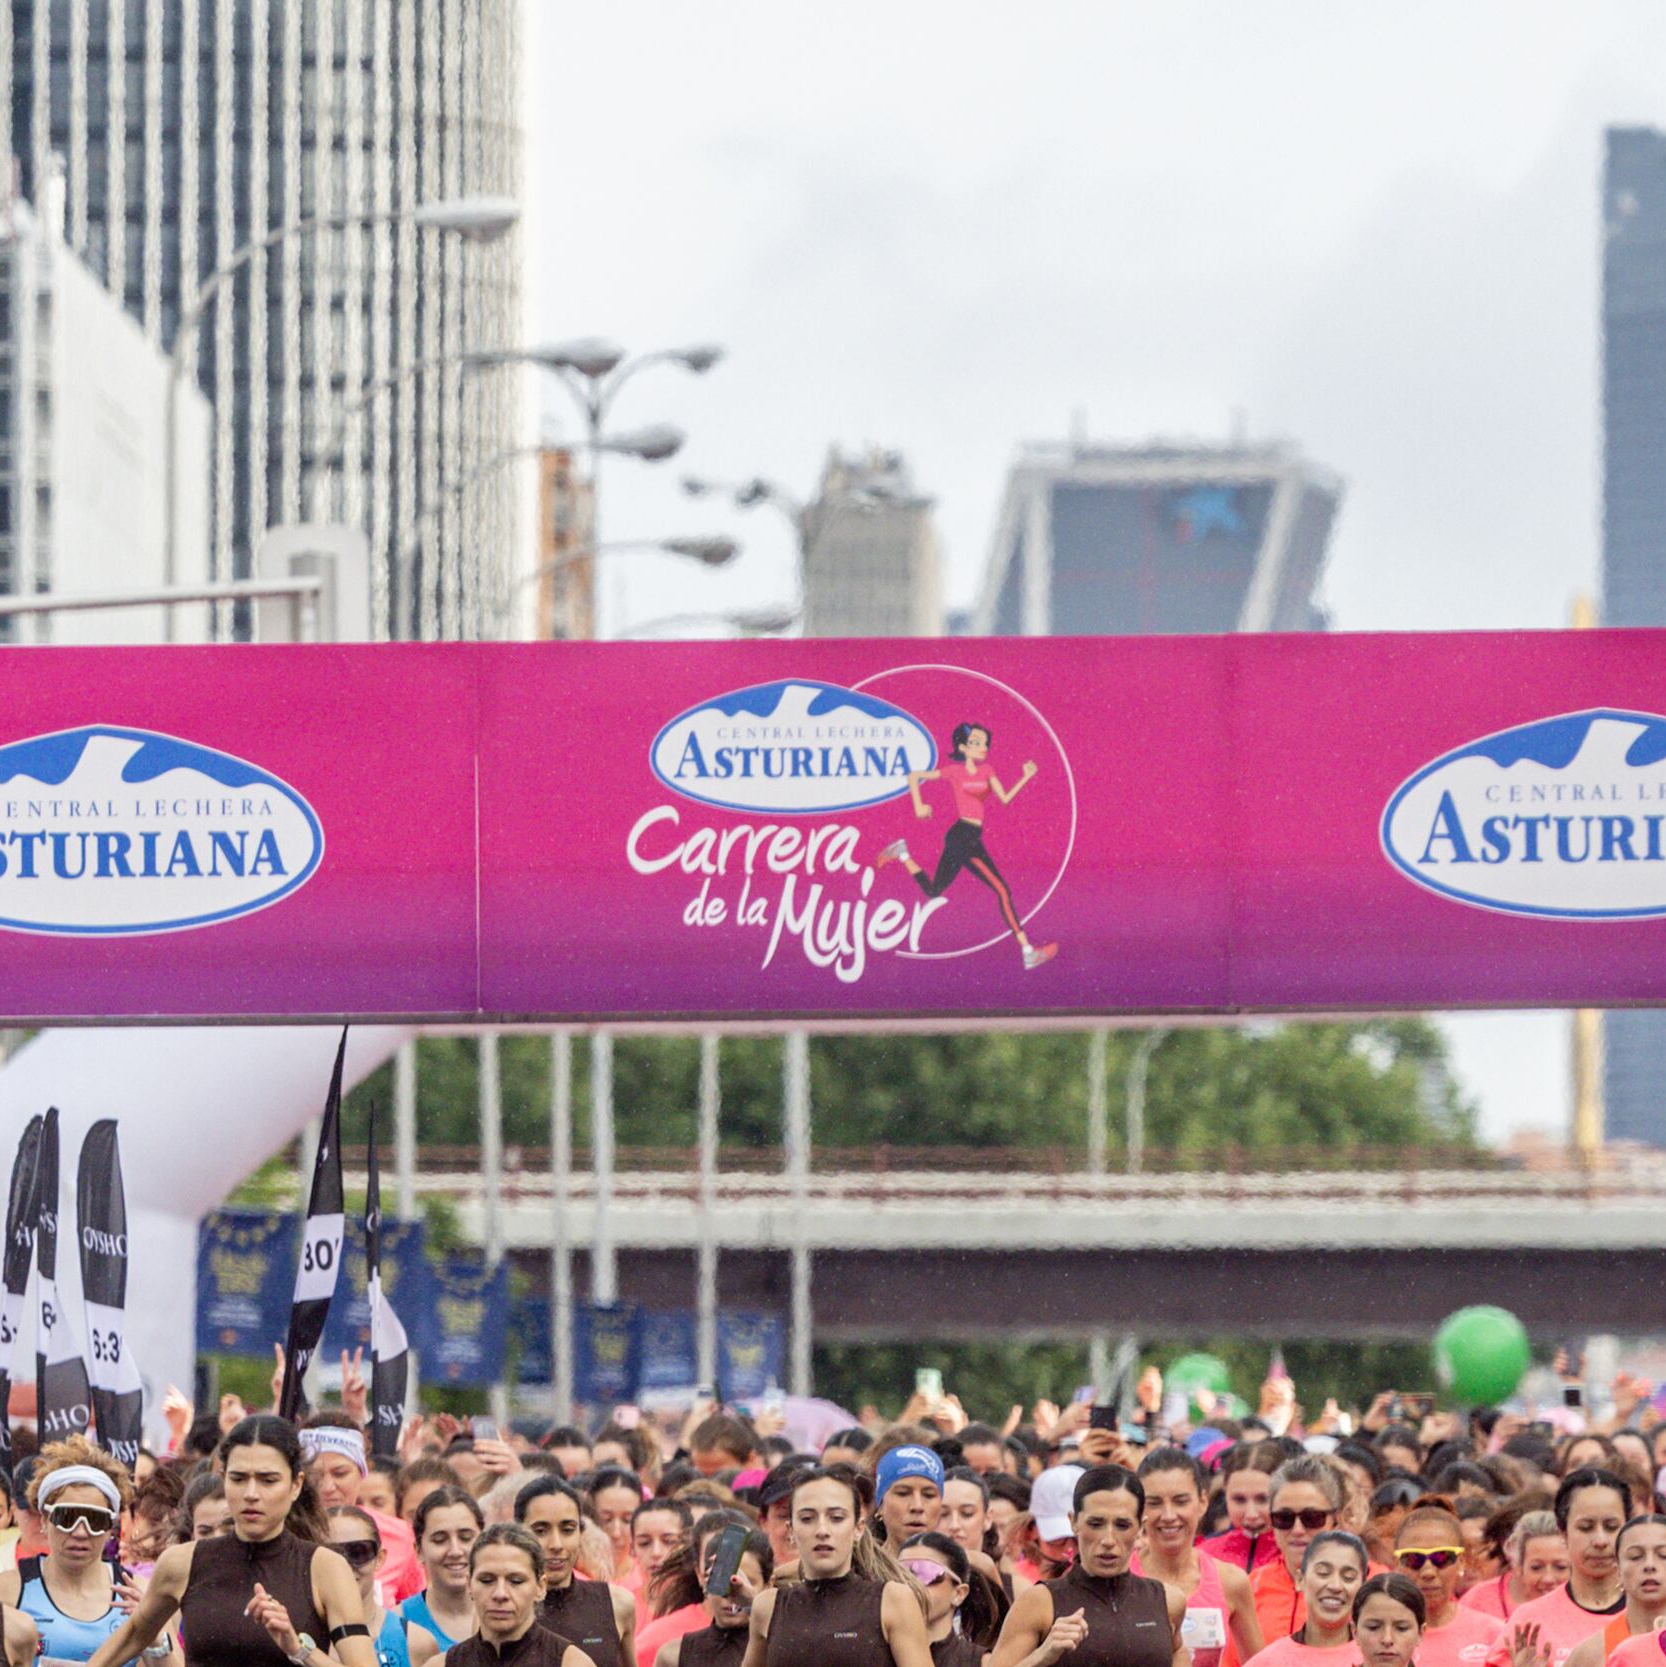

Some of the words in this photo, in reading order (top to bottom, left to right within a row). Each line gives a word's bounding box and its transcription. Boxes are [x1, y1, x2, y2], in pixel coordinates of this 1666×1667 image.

[717, 726, 807, 739] CENTRAL
[814, 725, 906, 738] LECHERA
[674, 730, 913, 780] ASTURIANA
[134, 798, 275, 818] LECHERA
[1484, 783, 1624, 803] CENTRAL
[626, 805, 861, 875] Carrera
[683, 878, 727, 927] de
[736, 876, 768, 926] la
[761, 873, 949, 983] Mujer
